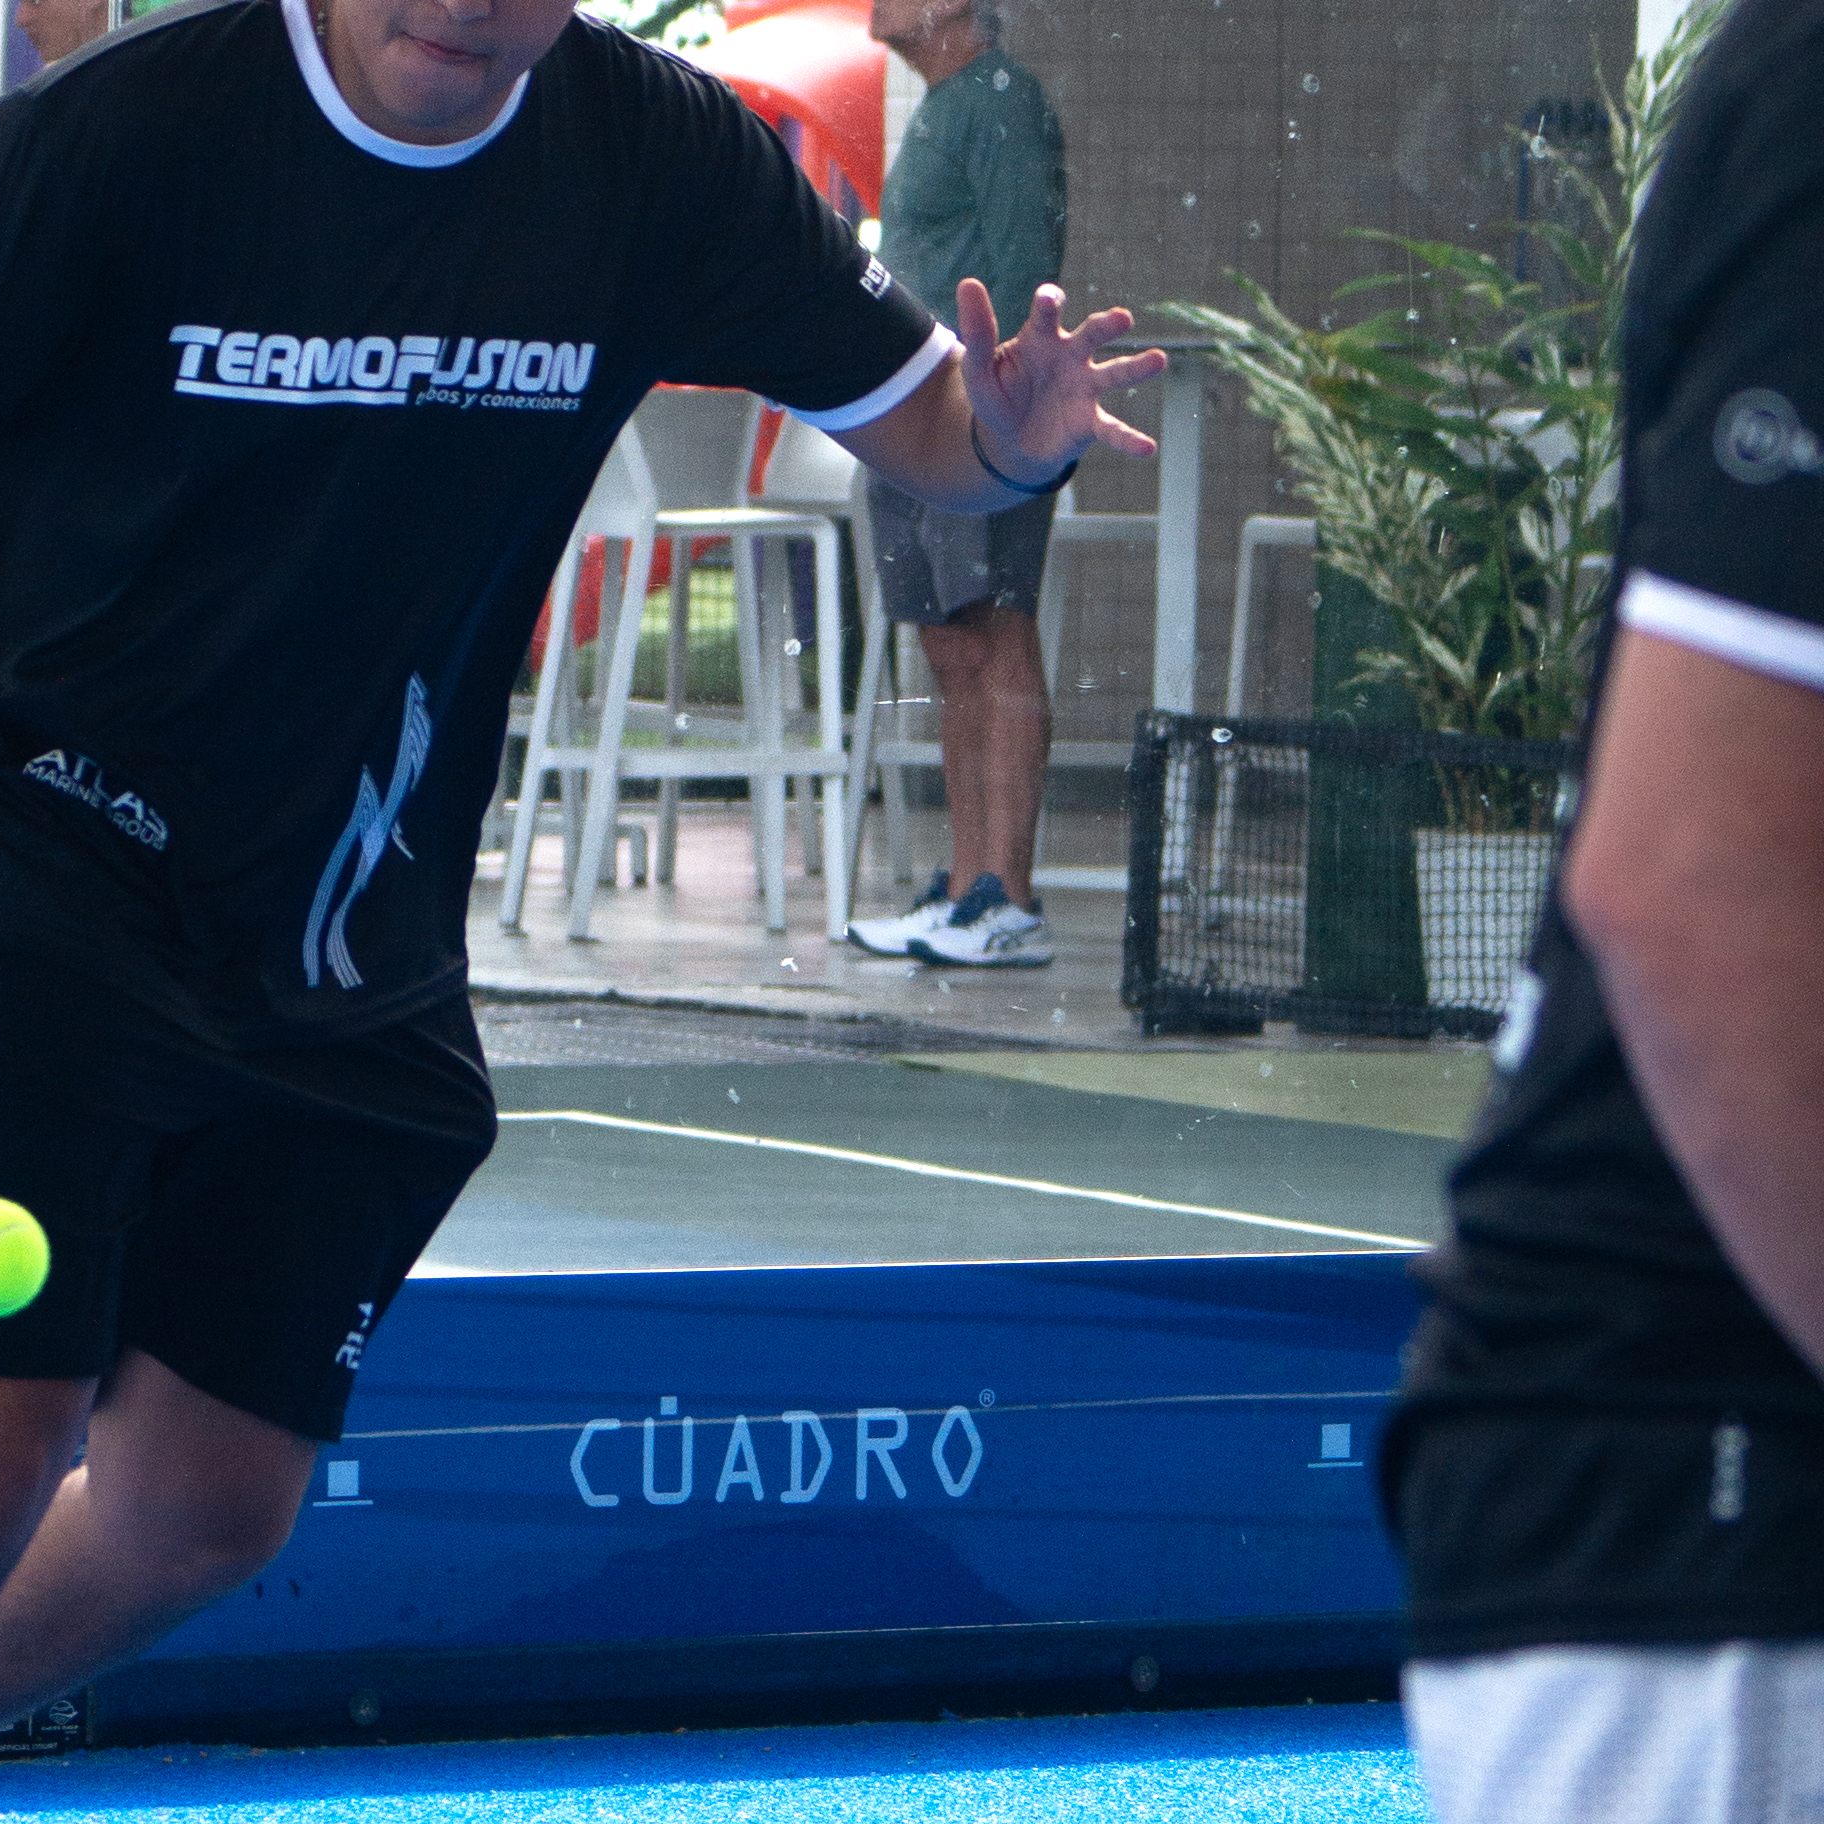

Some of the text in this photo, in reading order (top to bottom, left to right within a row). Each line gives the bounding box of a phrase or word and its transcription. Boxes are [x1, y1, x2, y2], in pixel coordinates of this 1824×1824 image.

[169, 325, 597, 393] TERMOFUSION
[460, 393, 478, 409] y
[480, 392, 581, 411] conexiones
[22, 762, 100, 809] MARINE
